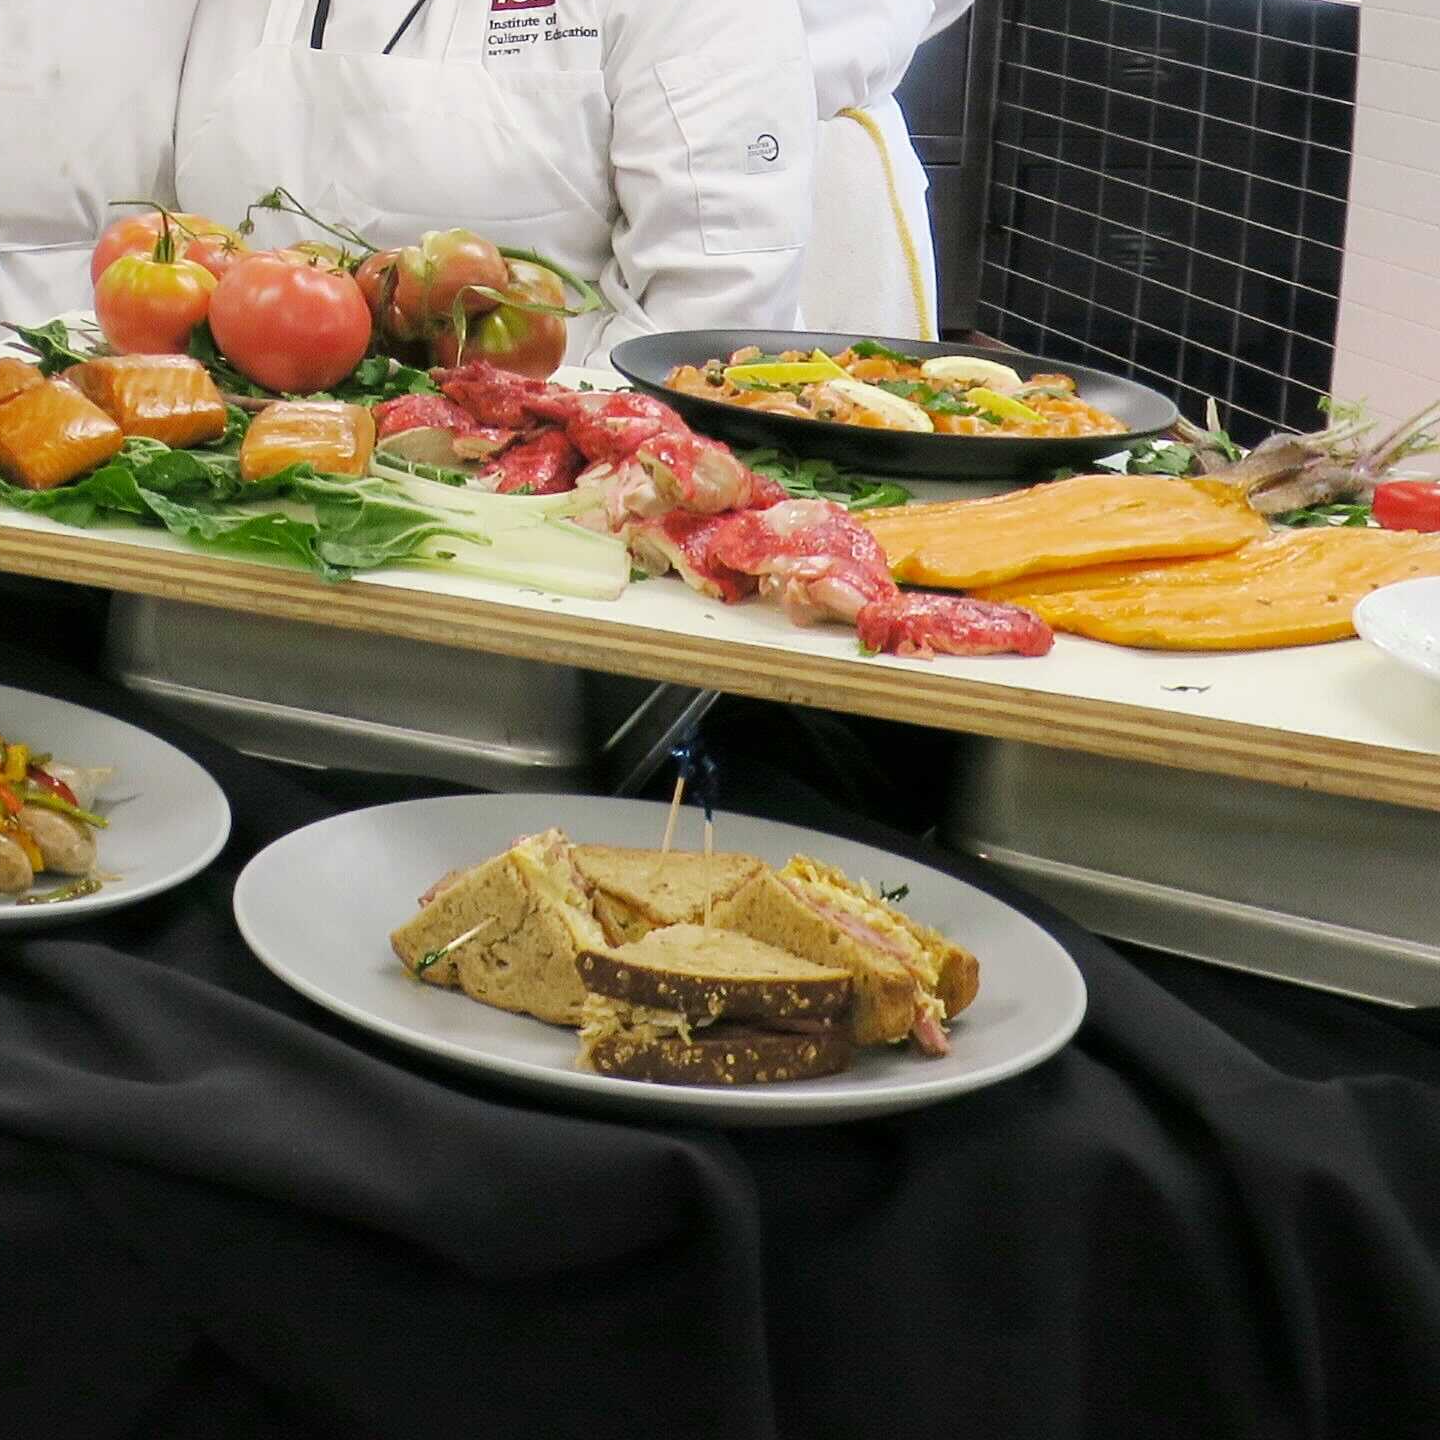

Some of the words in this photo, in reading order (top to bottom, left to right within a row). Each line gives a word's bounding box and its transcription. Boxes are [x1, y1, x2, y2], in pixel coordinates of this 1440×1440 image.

[489, 17, 540, 30] Institute
[488, 33, 538, 45] Culinary
[544, 26, 598, 41] Education
